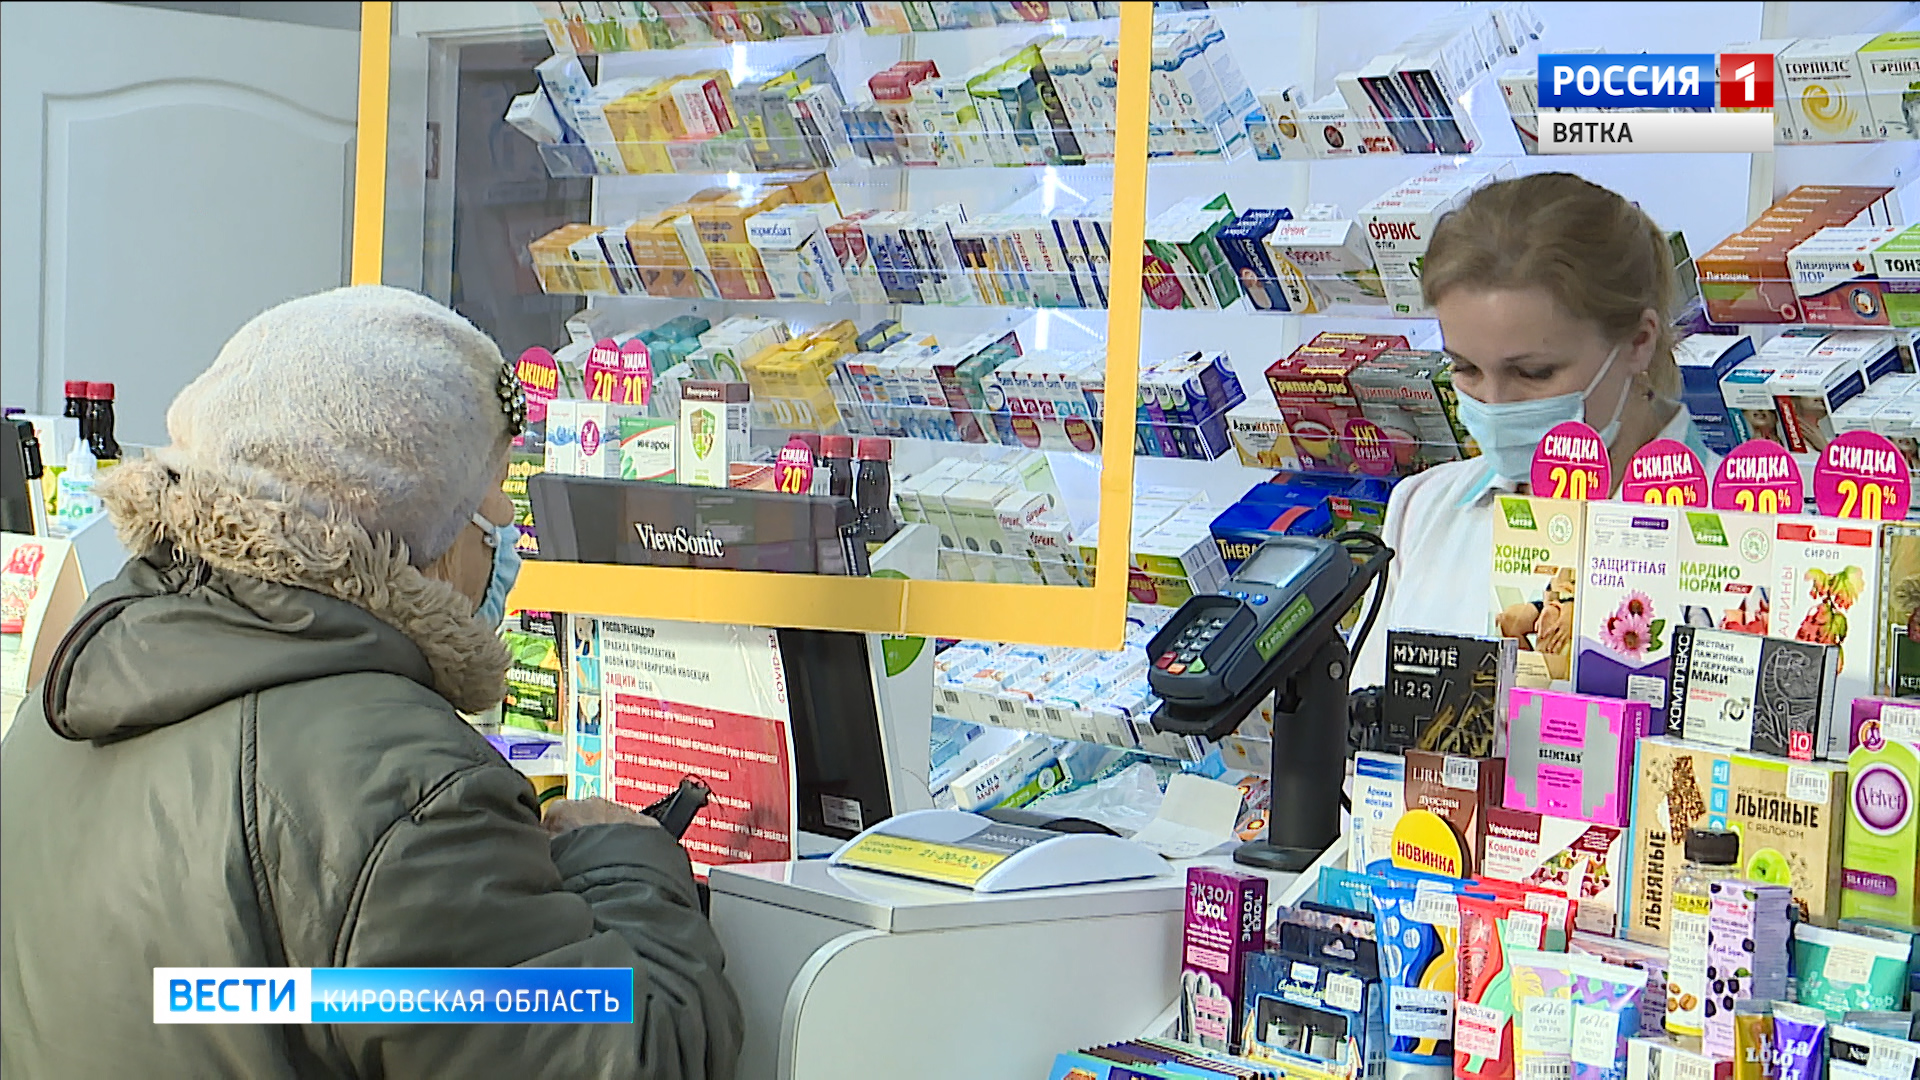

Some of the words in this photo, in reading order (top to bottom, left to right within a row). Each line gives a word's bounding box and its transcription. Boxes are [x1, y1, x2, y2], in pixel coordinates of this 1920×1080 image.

[1786, 60, 1849, 74] ГОРПИЛС
[1368, 220, 1421, 240] ОРВИС
[592, 347, 619, 367] СКИДКА
[518, 361, 556, 390] АКЦИЯ
[1268, 377, 1348, 394] ГриппоФлю
[1350, 425, 1379, 446] ХИТ
[781, 447, 809, 463] СКИДКА
[1354, 447, 1389, 461] ПРОДАЖ
[1544, 434, 1599, 461] СКИДКА
[1633, 453, 1693, 480] СКИДКА
[1726, 455, 1790, 481] СКИДКА
[1829, 445, 1897, 475] СКИДКА
[634, 522, 725, 557] ViewSonic
[1495, 544, 1550, 562] ХОНДРО
[1804, 548, 1840, 560] СИРОП
[1495, 560, 1531, 575] НОРМ
[1591, 557, 1666, 576] ЗАЩИТНАЯ
[1679, 561, 1740, 580] КАРДИО
[1590, 573, 1625, 588] СИЛА
[1679, 578, 1721, 593] НОРМ
[1777, 565, 1793, 638] АЛИНЫ
[1696, 640, 1735, 651] ЭКСТРАКТ
[1394, 644, 1458, 667] МУМИЁ
[1694, 649, 1744, 664] ПАЖИТНИКА
[1691, 669, 1728, 685] МАКИ
[1700, 661, 1754, 676] ПЕРУАНСКОЙ
[1668, 634, 1690, 730] КОМПЛЕКС
[1791, 733, 1809, 750] 10
[1539, 749, 1581, 763] SLIMTABS
[1861, 785, 1901, 810] Velvet
[1735, 794, 1819, 828] ЛЬНЯНЫЕ
[1756, 823, 1804, 839] ЯБЛОКОМ
[1397, 841, 1455, 876] НОВИНКА
[1645, 829, 1666, 930] ЛЬНЯНЫЕ
[1863, 877, 1886, 889] EFFECT
[1190, 881, 1234, 904] ЭКЗОЛ
[1197, 902, 1228, 921] EXOL
[1242, 889, 1253, 942] ЭКЗОЛ
[1253, 895, 1263, 932] EXOL
